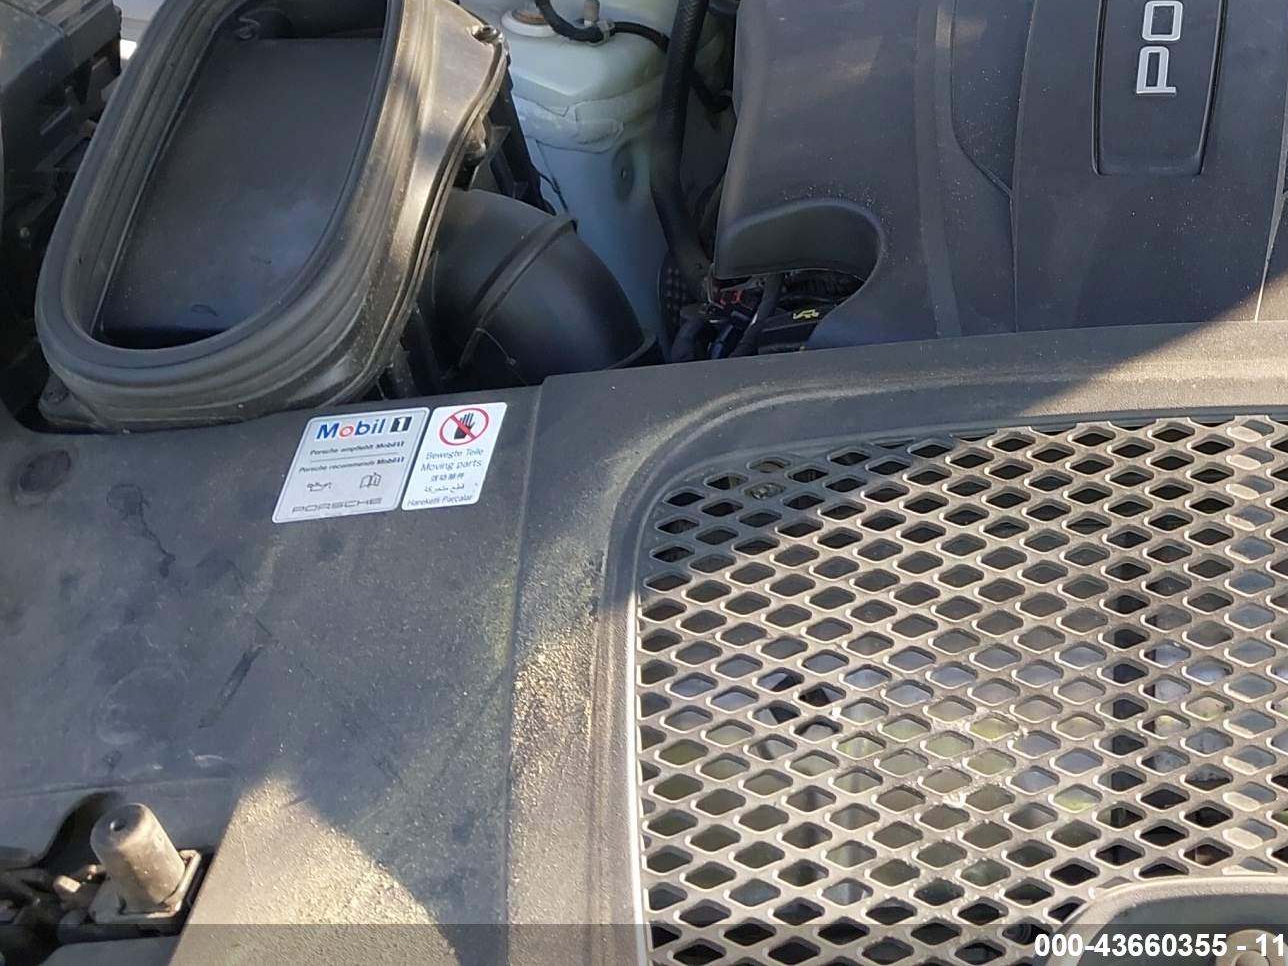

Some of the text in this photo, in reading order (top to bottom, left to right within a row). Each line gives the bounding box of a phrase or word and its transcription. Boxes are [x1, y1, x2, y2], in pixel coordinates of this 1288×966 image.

[316, 418, 385, 439] Mobil
[310, 447, 338, 455] Porsche
[426, 450, 463, 460] Bewegte
[299, 464, 327, 472] Porsche
[421, 460, 482, 471] Moving parts
[292, 498, 383, 513] PORSCHE
